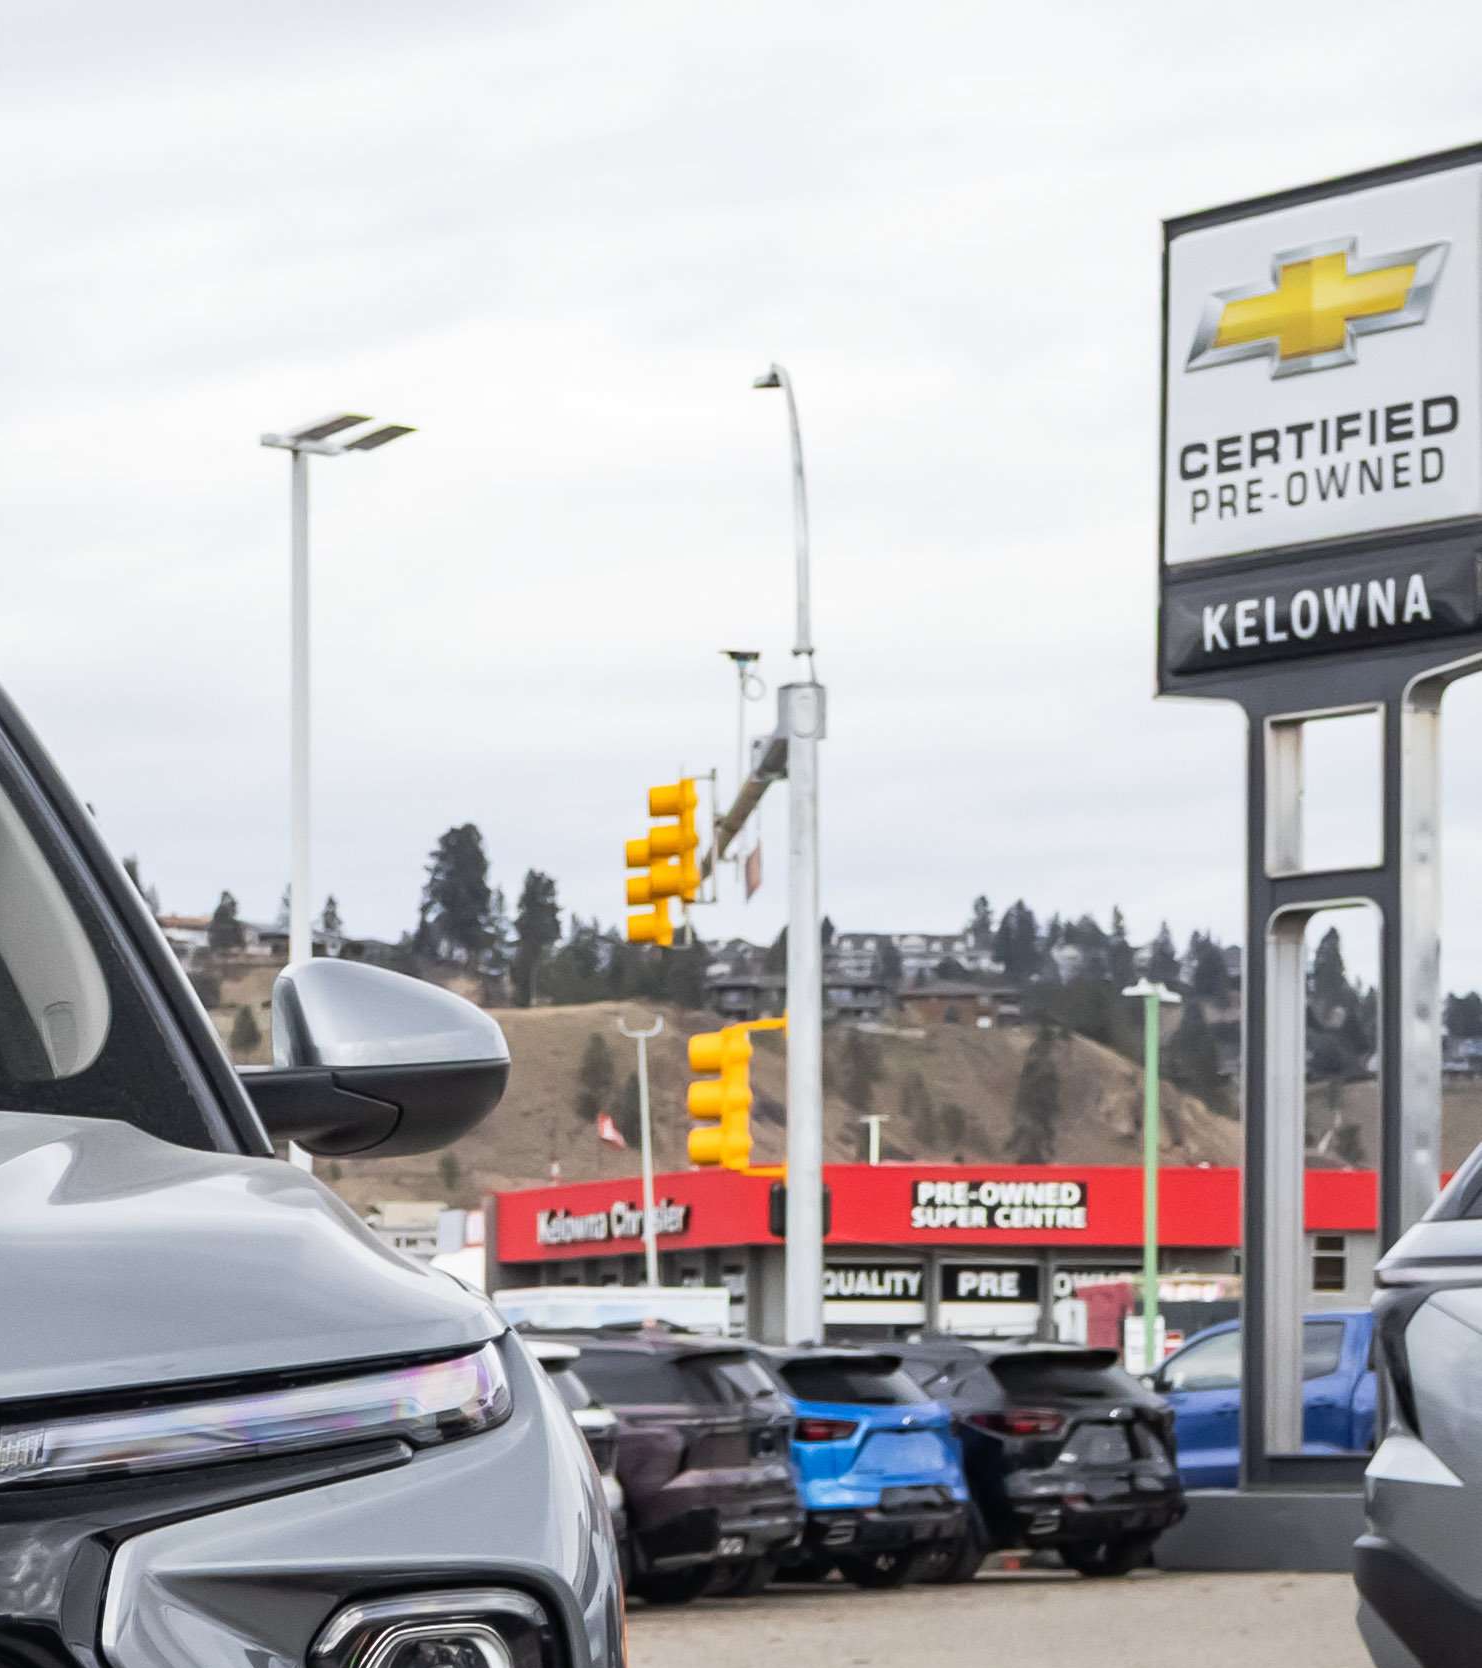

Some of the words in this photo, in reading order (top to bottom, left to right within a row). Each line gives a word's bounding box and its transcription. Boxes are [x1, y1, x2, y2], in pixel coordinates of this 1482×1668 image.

[1180, 395, 1459, 480] CERTIFIED
[1191, 447, 1444, 524] PRE-OWNED
[1202, 574, 1432, 651] KELOWNA
[917, 1181, 1082, 1206] PRE-OWNED
[538, 1209, 609, 1246] Kelowna
[911, 1206, 987, 1229] SUPER
[994, 1206, 1088, 1229] CENTRE
[957, 1271, 1020, 1297] PRE
